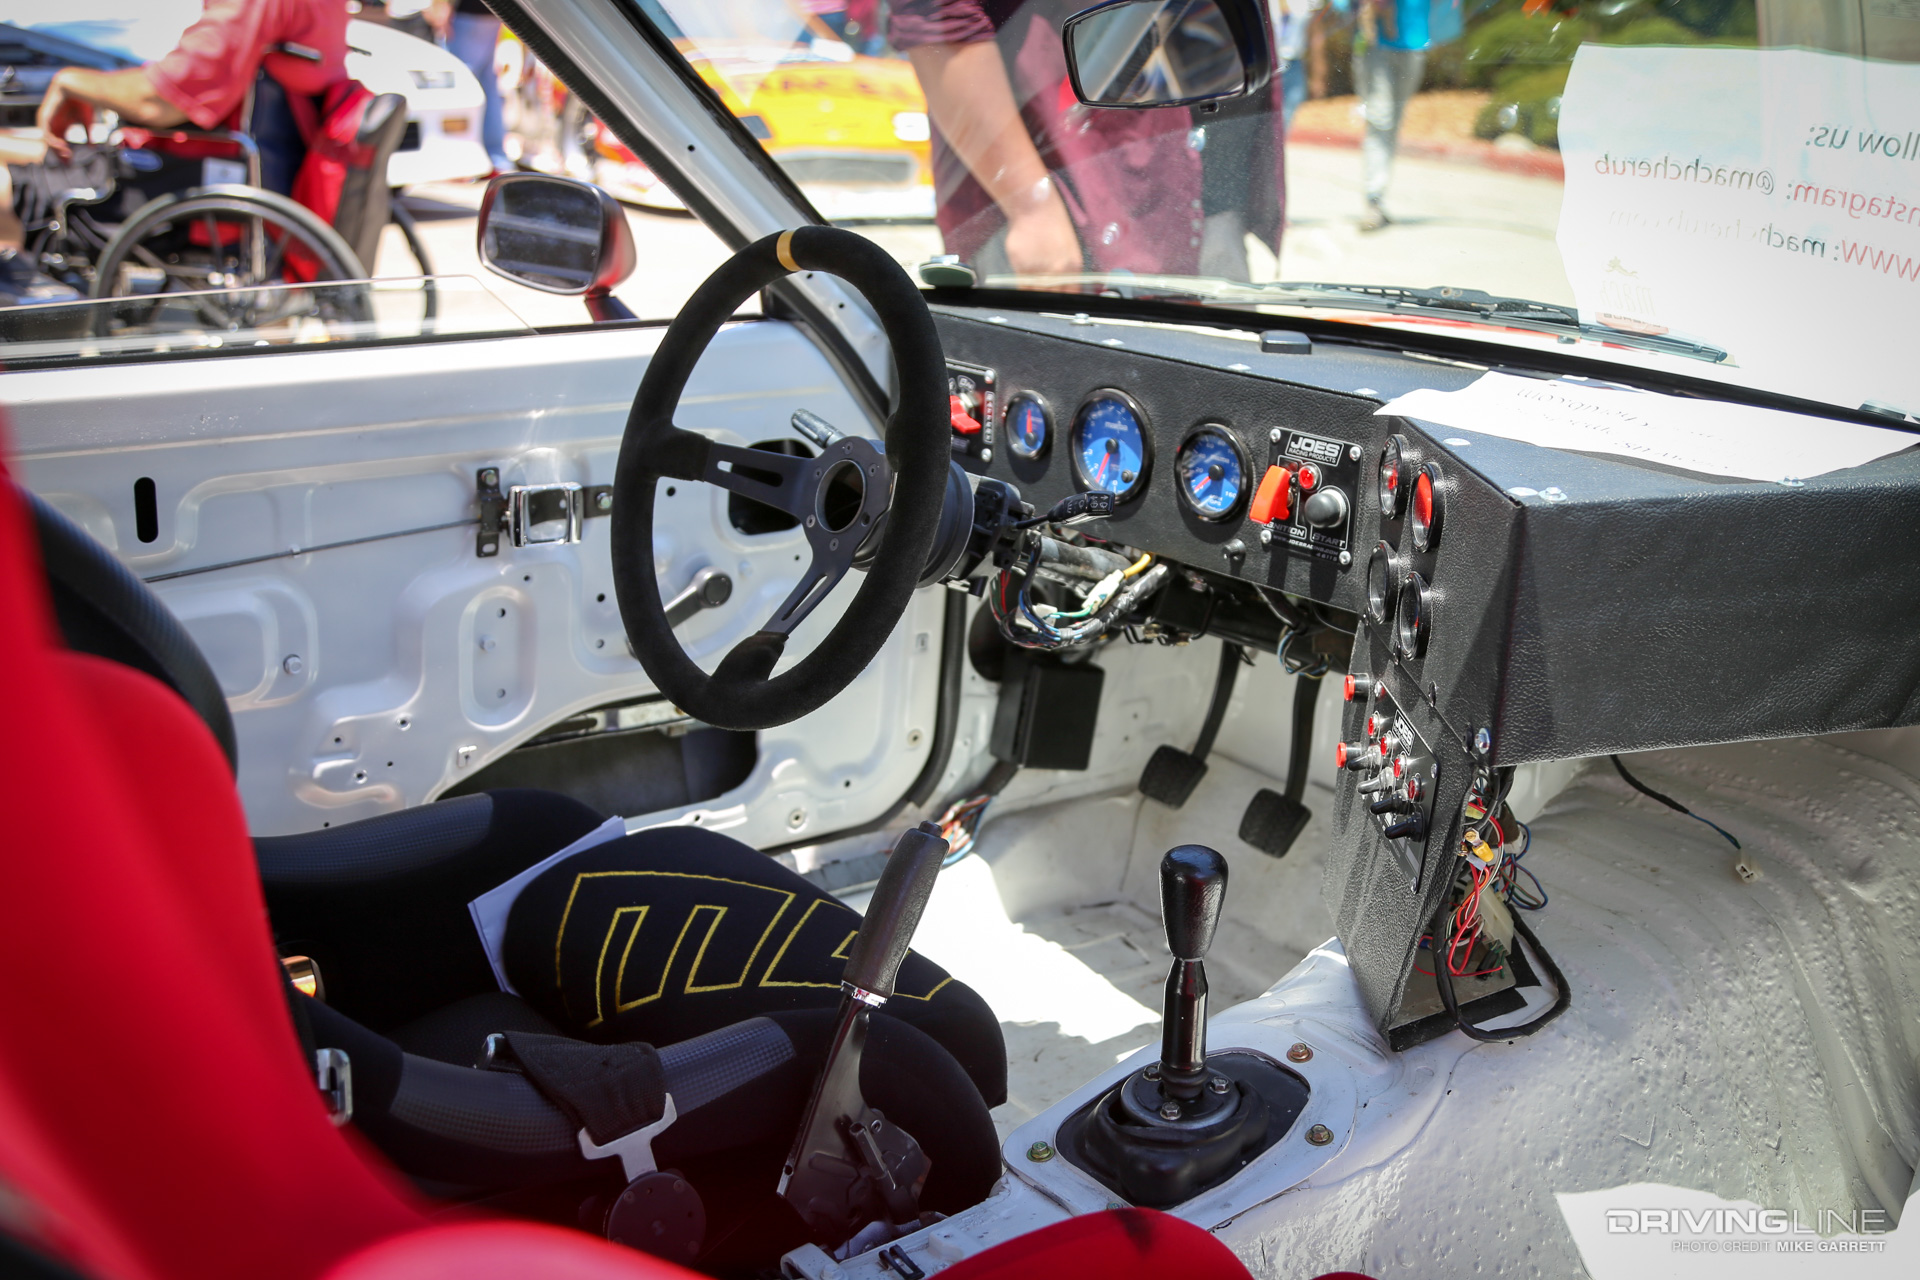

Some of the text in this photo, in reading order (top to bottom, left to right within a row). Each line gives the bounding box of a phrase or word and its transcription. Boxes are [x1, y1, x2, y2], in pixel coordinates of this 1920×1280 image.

[1288, 447, 1337, 464] RACING PRODUCTS
[1290, 436, 1340, 458] JOES
[1312, 532, 1346, 547] START
